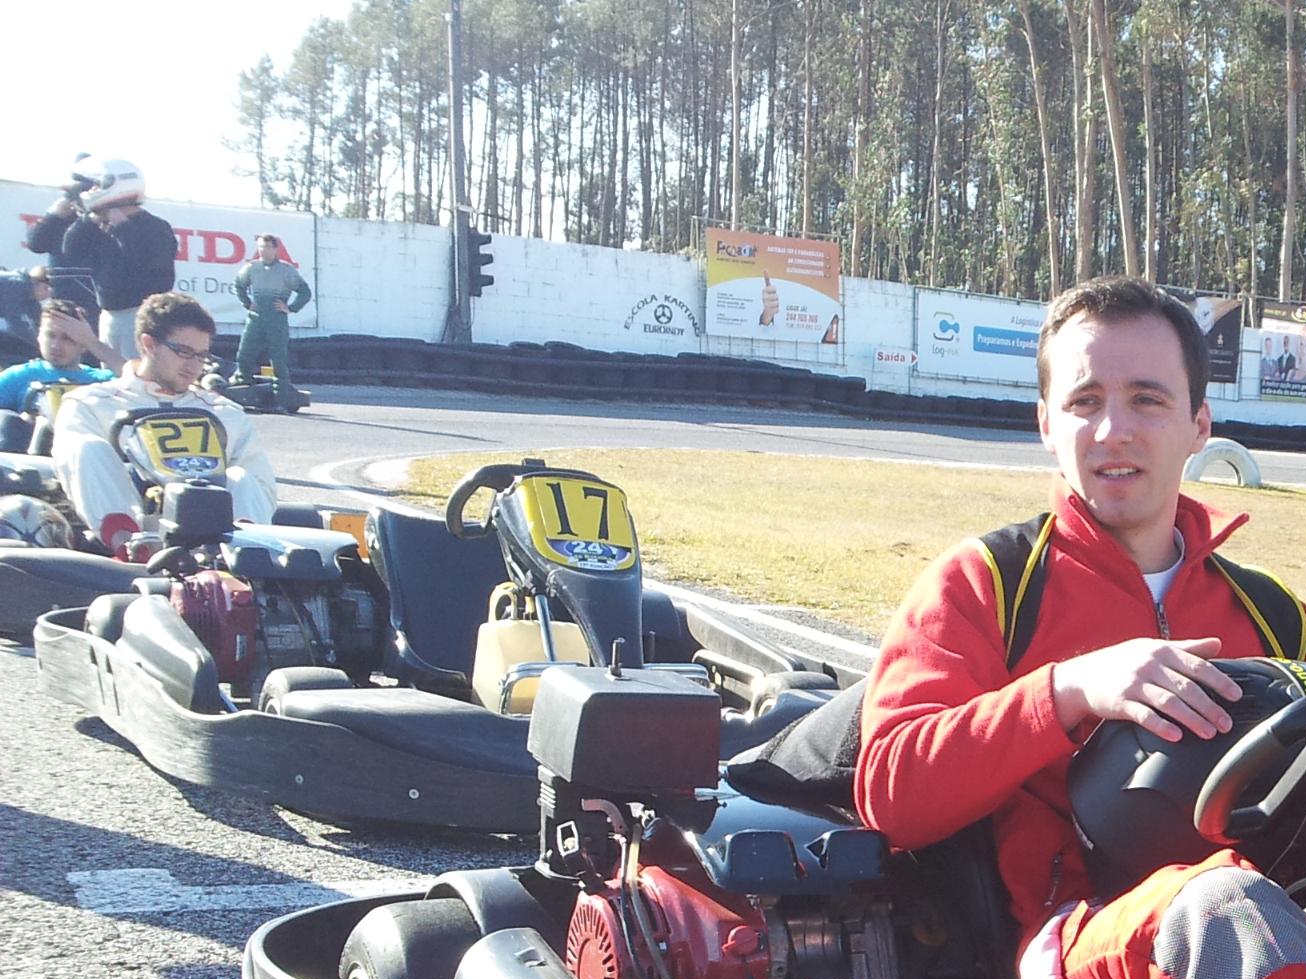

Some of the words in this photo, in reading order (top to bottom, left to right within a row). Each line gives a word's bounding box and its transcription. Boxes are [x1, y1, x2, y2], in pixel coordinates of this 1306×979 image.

[177, 276, 198, 293] of
[664, 294, 702, 338] KARTING
[876, 350, 906, 363] Saída
[148, 420, 212, 454] 27
[545, 481, 609, 541] 17
[571, 540, 604, 555] 24
